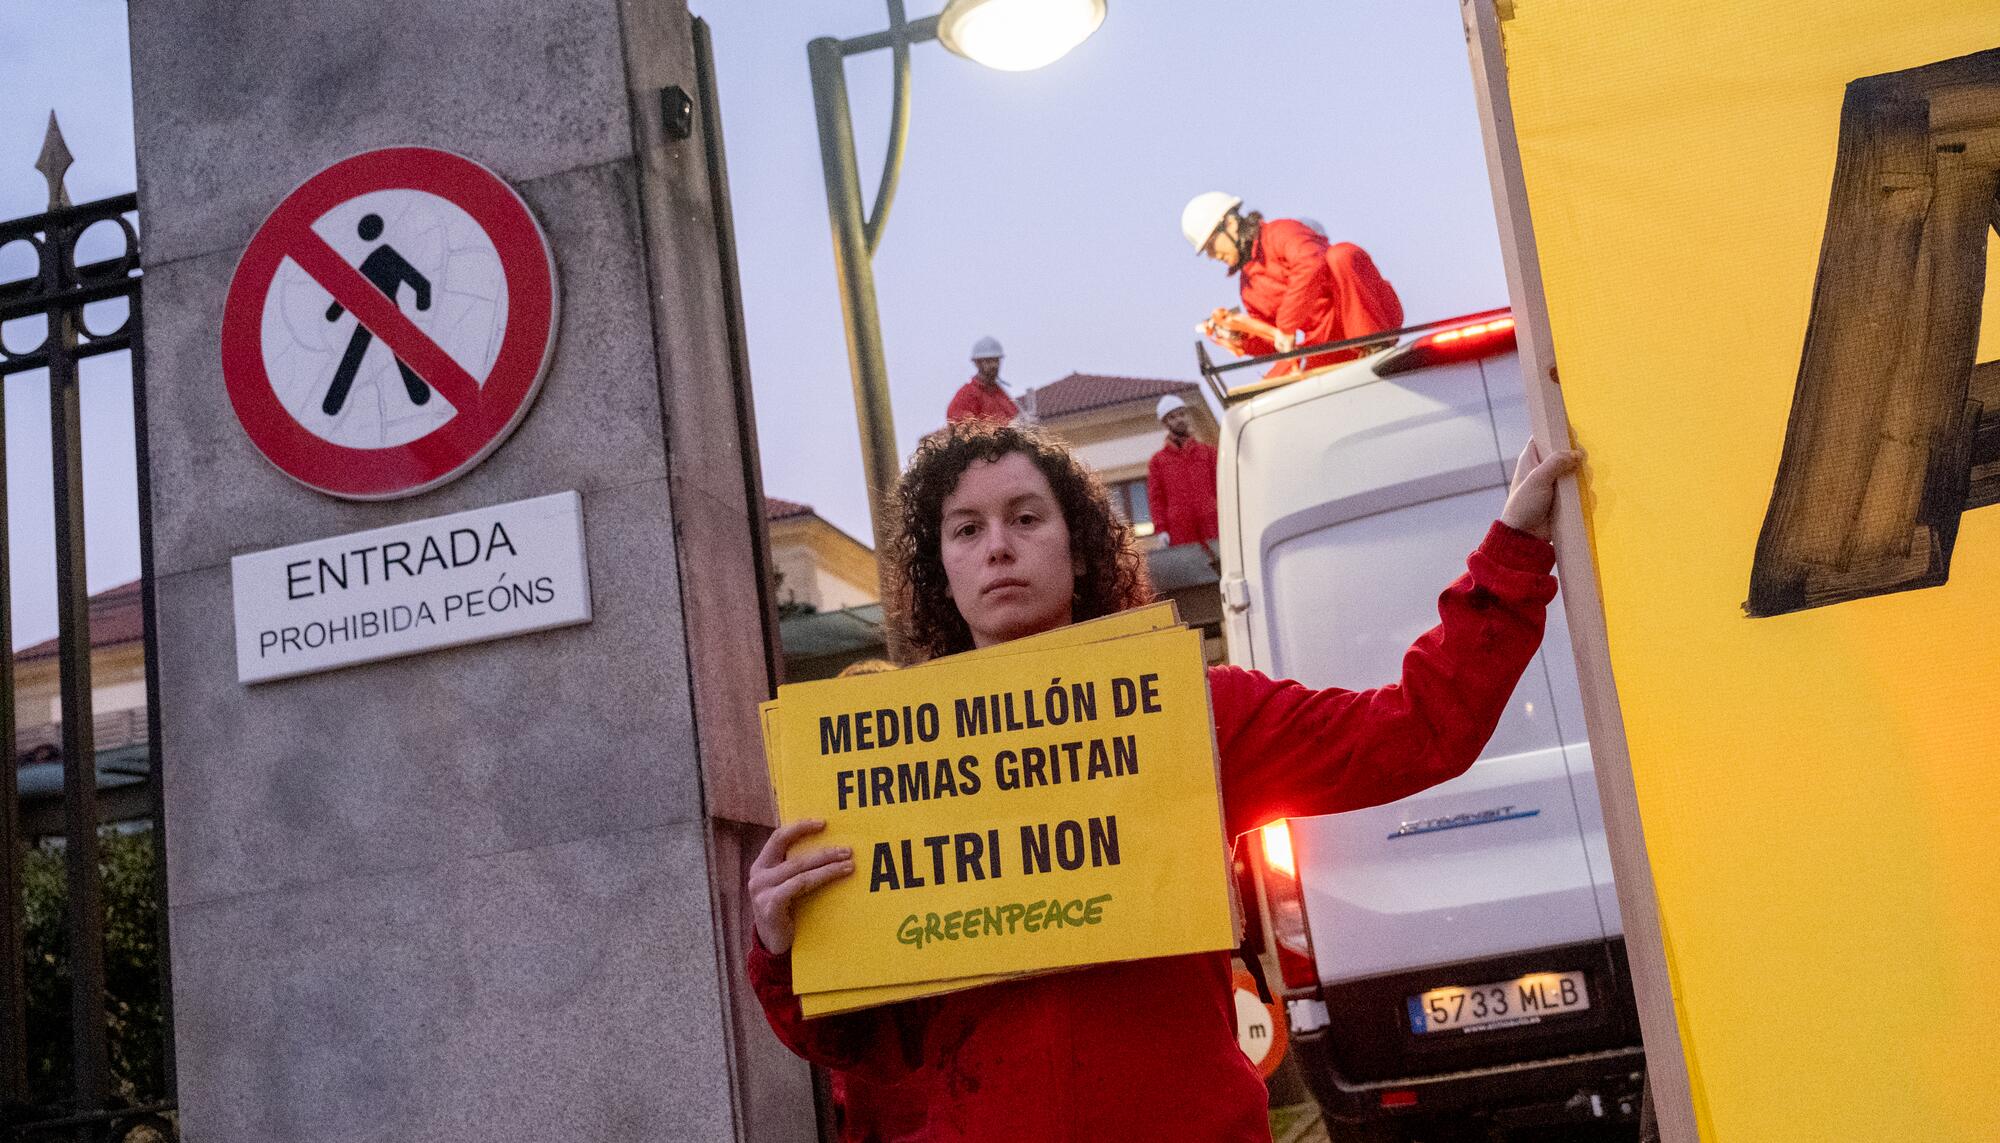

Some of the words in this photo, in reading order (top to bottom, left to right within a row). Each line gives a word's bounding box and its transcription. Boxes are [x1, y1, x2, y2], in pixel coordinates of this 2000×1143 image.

[287, 522, 517, 600] ENTRADA
[260, 601, 436, 658] PROHIBIDA
[444, 573, 555, 622] PEÓNS
[820, 703, 940, 755] MEDIO
[955, 677, 1097, 738] MILLÓN
[1112, 673, 1162, 718] DE
[837, 755, 981, 811] FIRMAS
[995, 735, 1139, 791] GRITAN
[869, 829, 1001, 893] ALTRI
[1020, 815, 1121, 875] NON
[896, 893, 1113, 949] GREENPEACE
[1249, 1023, 1267, 1040] m
[1430, 989, 1509, 1024] 5733
[1519, 978, 1579, 1012] MLB
